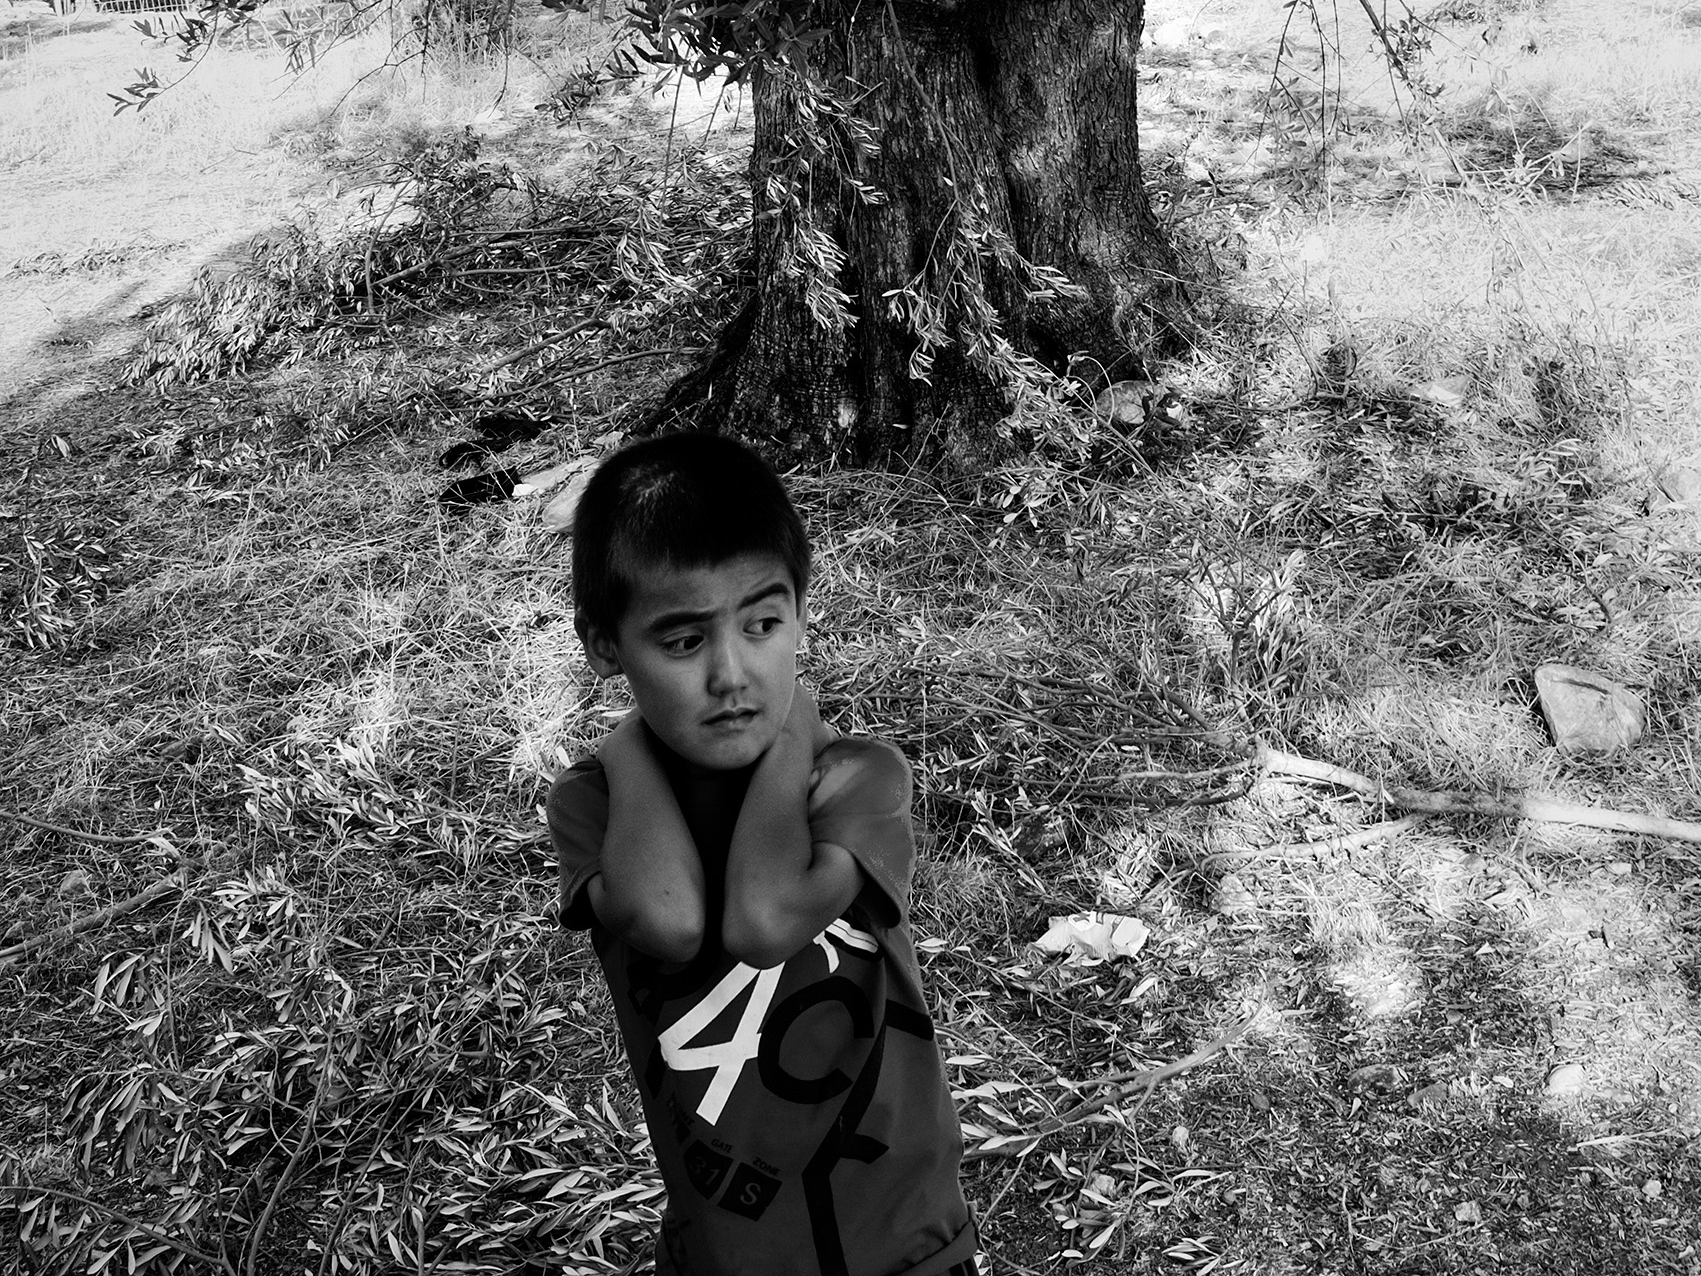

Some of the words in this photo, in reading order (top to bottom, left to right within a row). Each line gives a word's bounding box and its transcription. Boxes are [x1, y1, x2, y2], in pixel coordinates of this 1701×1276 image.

[711, 1138, 733, 1153] GATE
[689, 1156, 720, 1187] 31
[752, 1156, 781, 1177] ZONE
[740, 1181, 762, 1206] S
